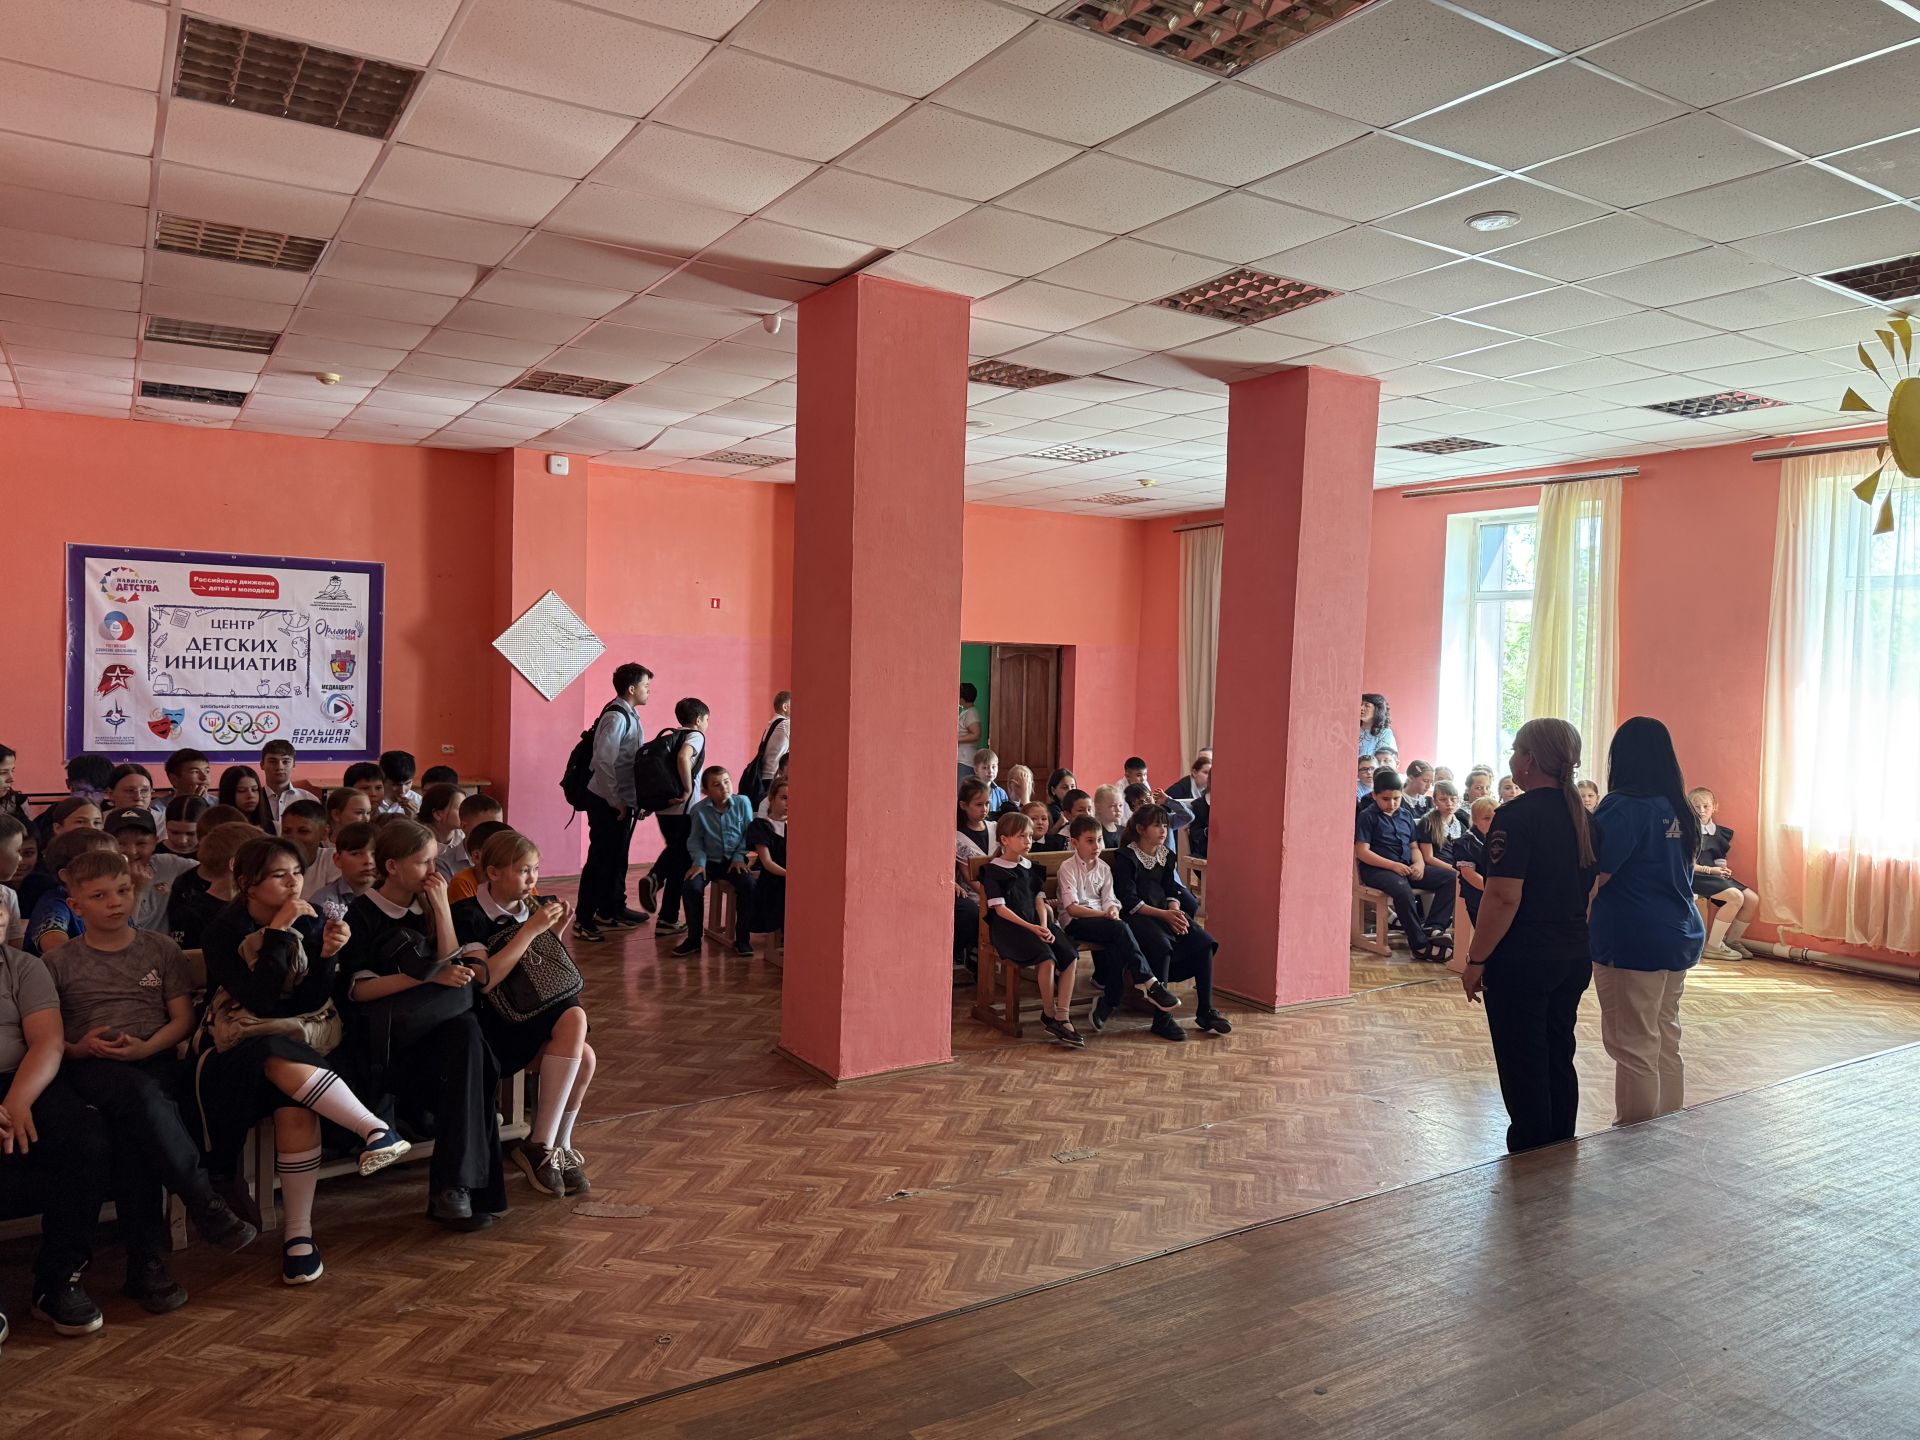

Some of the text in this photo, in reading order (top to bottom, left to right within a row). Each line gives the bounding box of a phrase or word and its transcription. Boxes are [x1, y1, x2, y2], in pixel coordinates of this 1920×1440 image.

[193, 576, 238, 584] Российское
[116, 583, 160, 592] ДЕТСТВА
[211, 619, 255, 630] ЦЕНТР
[185, 637, 278, 653] ДЕТСКИХ
[165, 655, 297, 673] ИНИЦИАТИВ
[293, 728, 351, 736] БОЛЬШАЯ
[291, 736, 349, 744] ПЕРЕМЕНА
